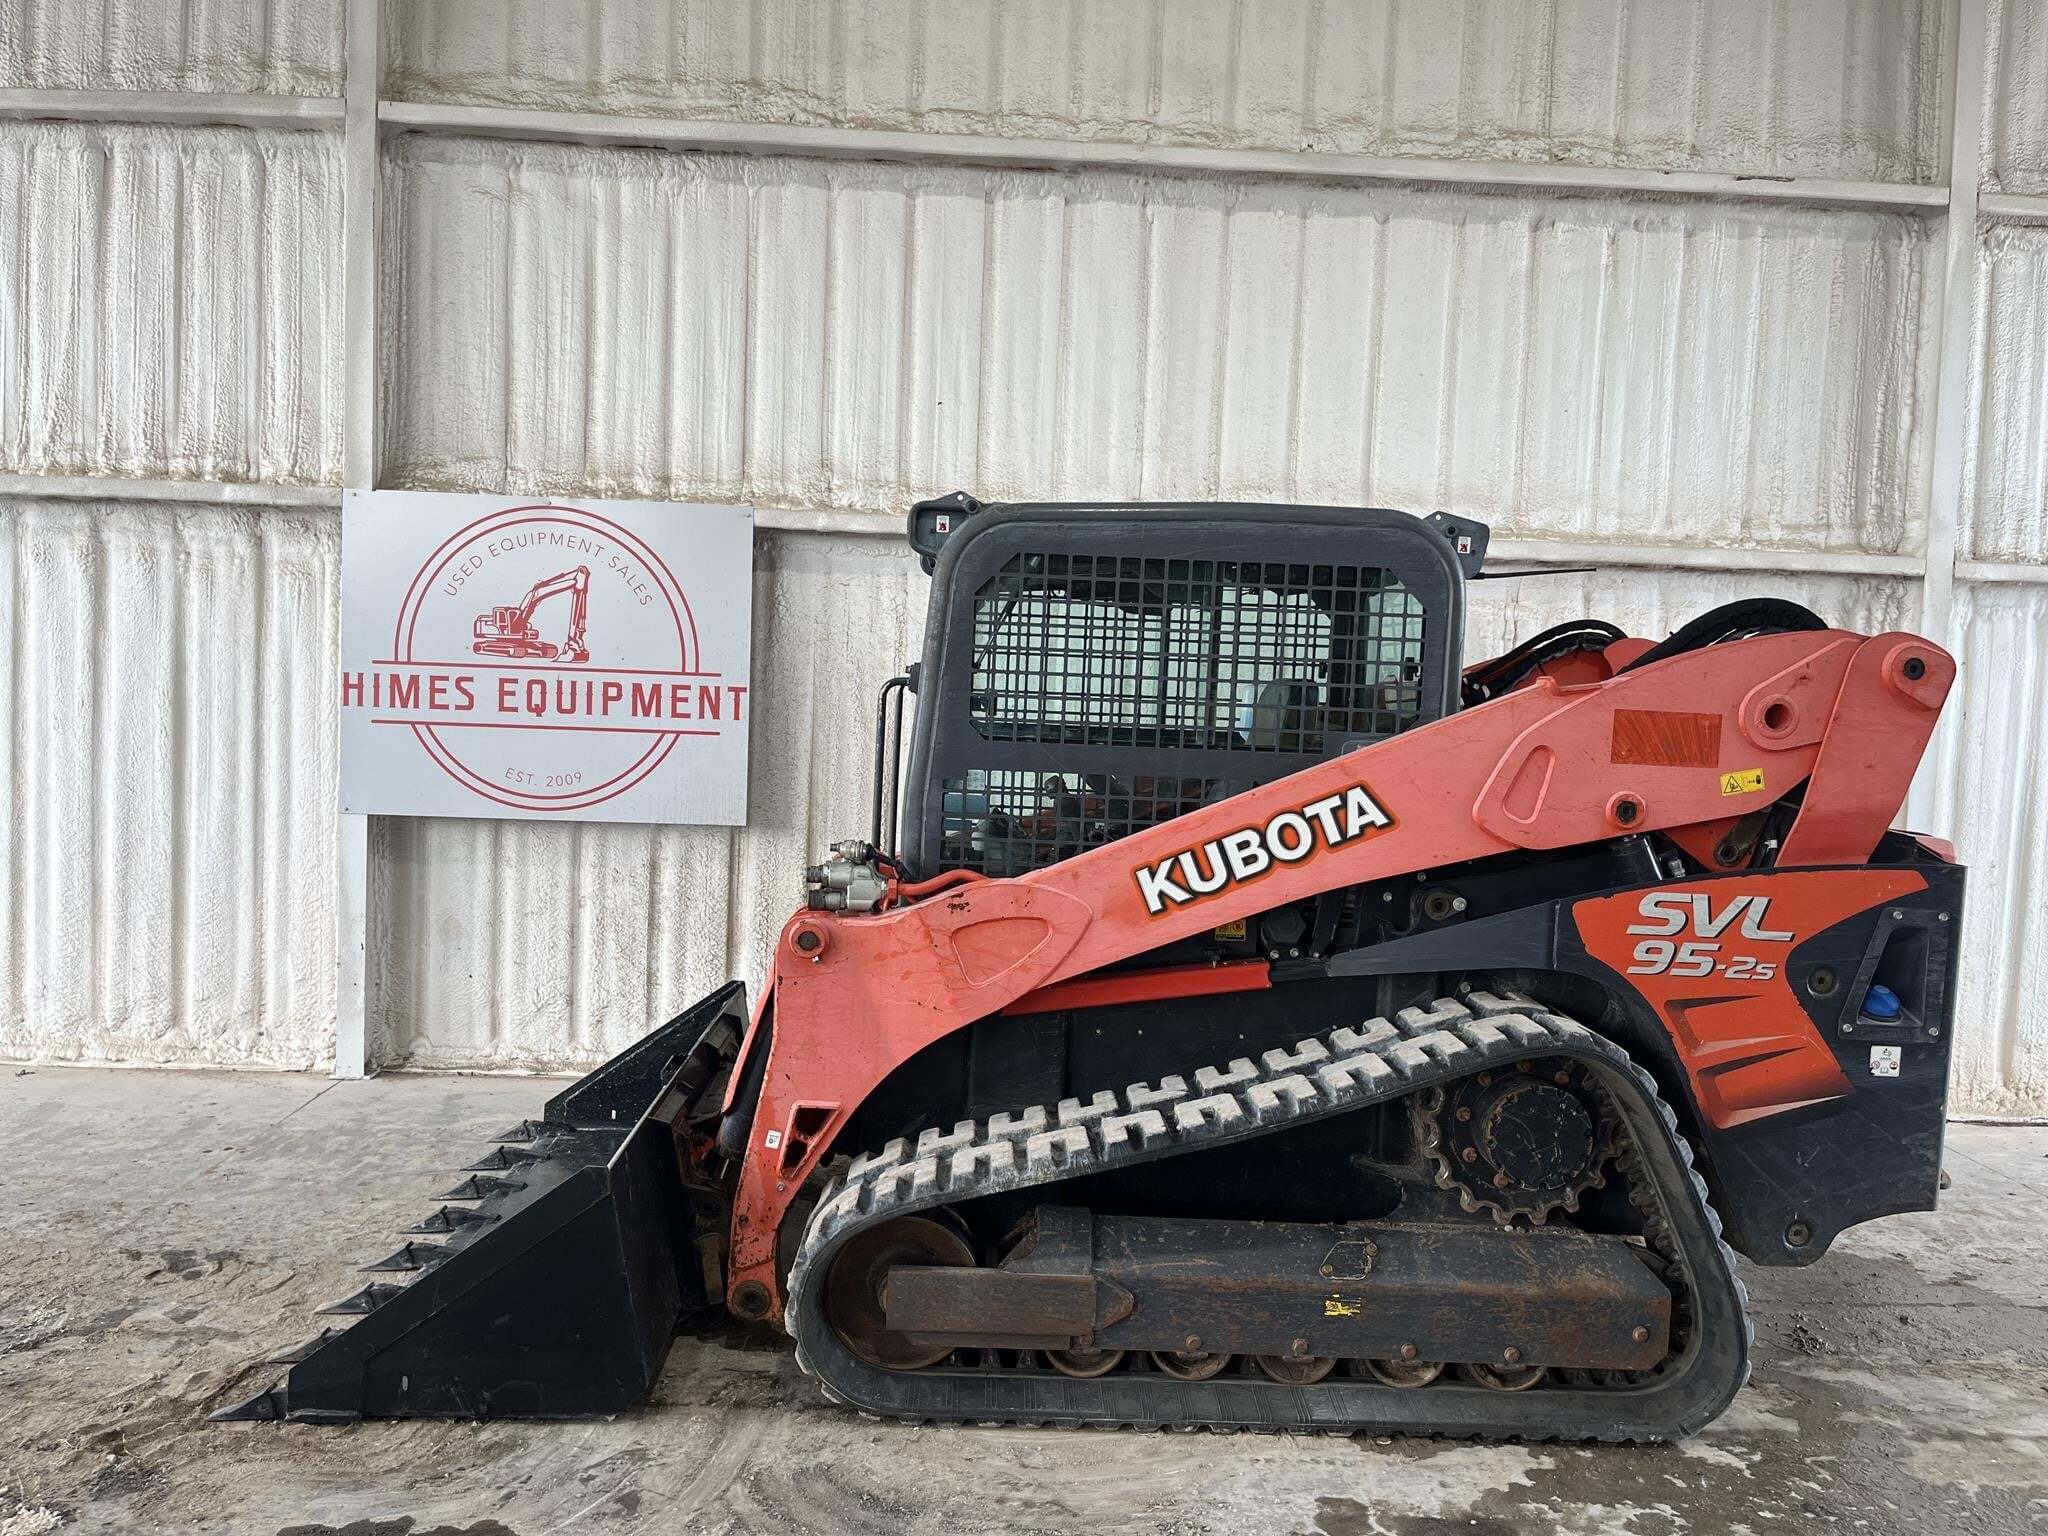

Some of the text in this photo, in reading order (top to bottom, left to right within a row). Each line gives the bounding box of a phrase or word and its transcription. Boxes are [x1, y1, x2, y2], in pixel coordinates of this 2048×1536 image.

[444, 532, 653, 606] USED EQUIPMENT SALES
[342, 671, 748, 721] HIMES EQUIPMENT
[504, 767, 582, 787] EST. 2009
[1135, 786, 1391, 914] KUBOTA
[1626, 892, 1795, 941] SVL
